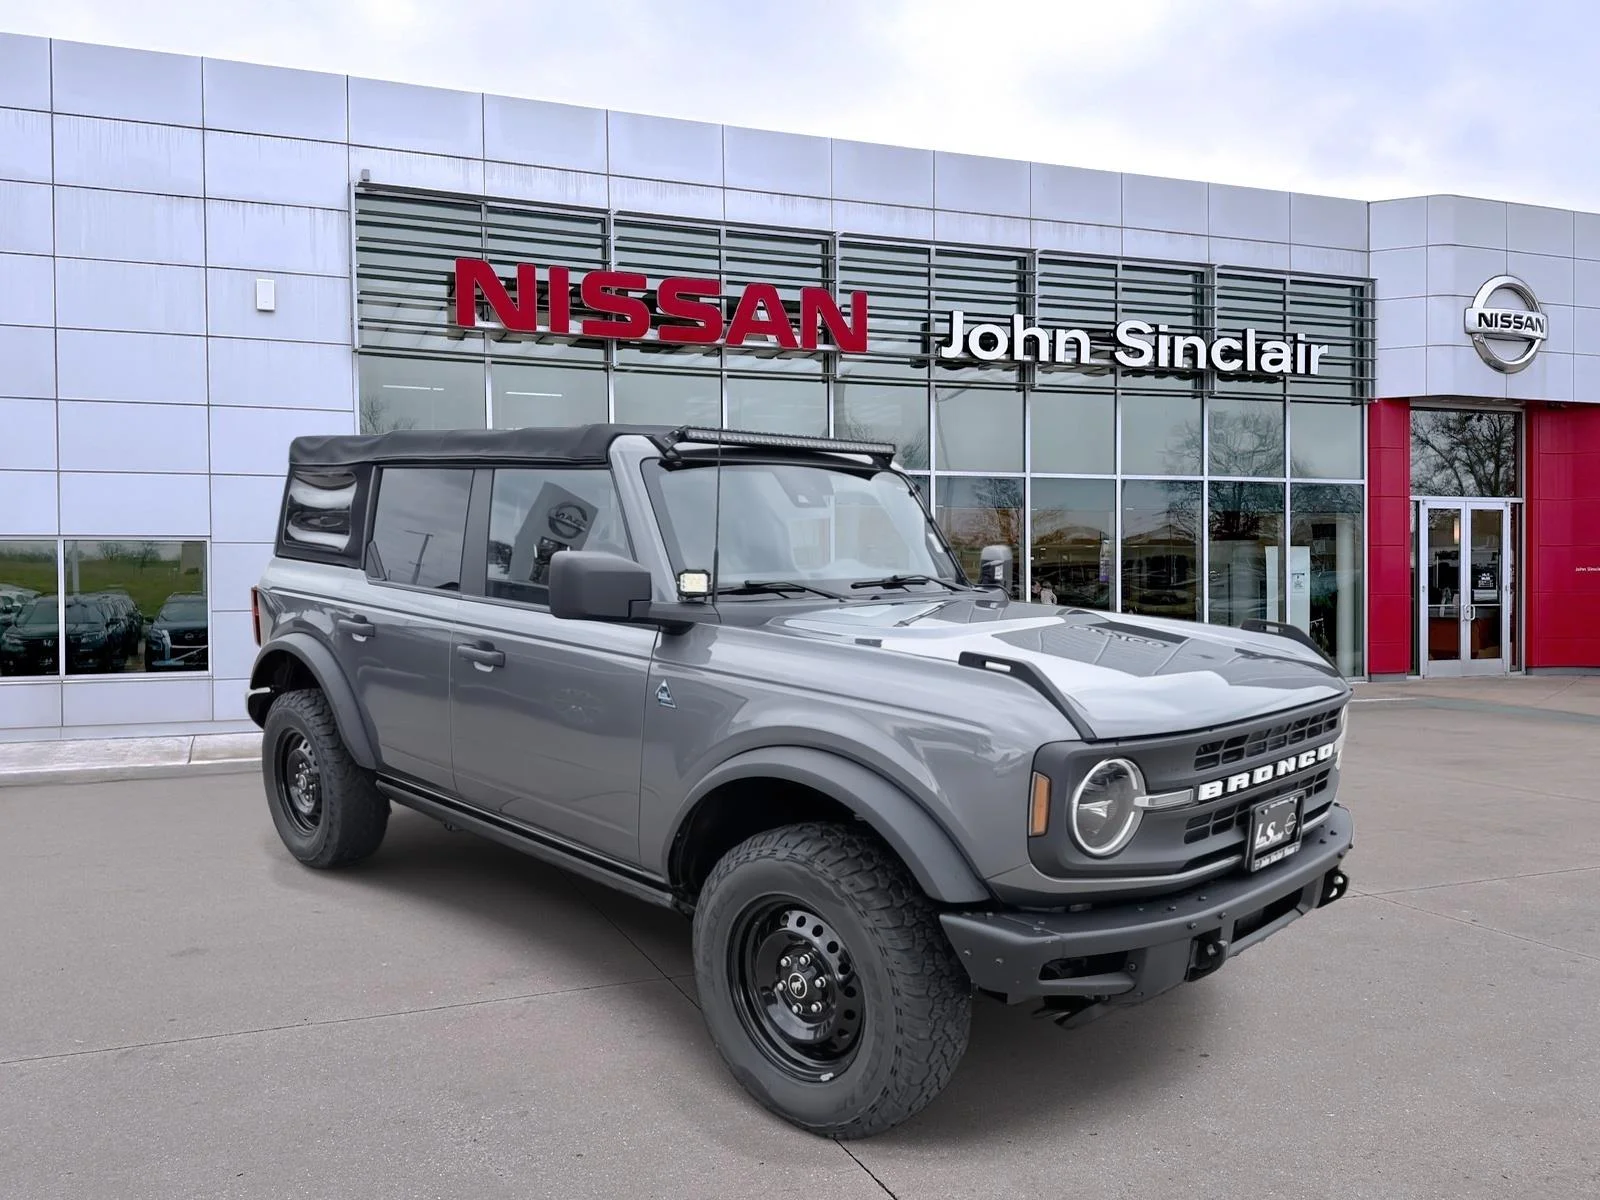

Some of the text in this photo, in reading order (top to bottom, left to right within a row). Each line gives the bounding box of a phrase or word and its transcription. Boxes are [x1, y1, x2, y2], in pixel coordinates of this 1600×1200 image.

[455, 258, 868, 353] NISSAN
[1477, 311, 1545, 333] NISSAN
[940, 310, 1329, 375] John Sinclair
[1198, 743, 1334, 801] BRONCO
